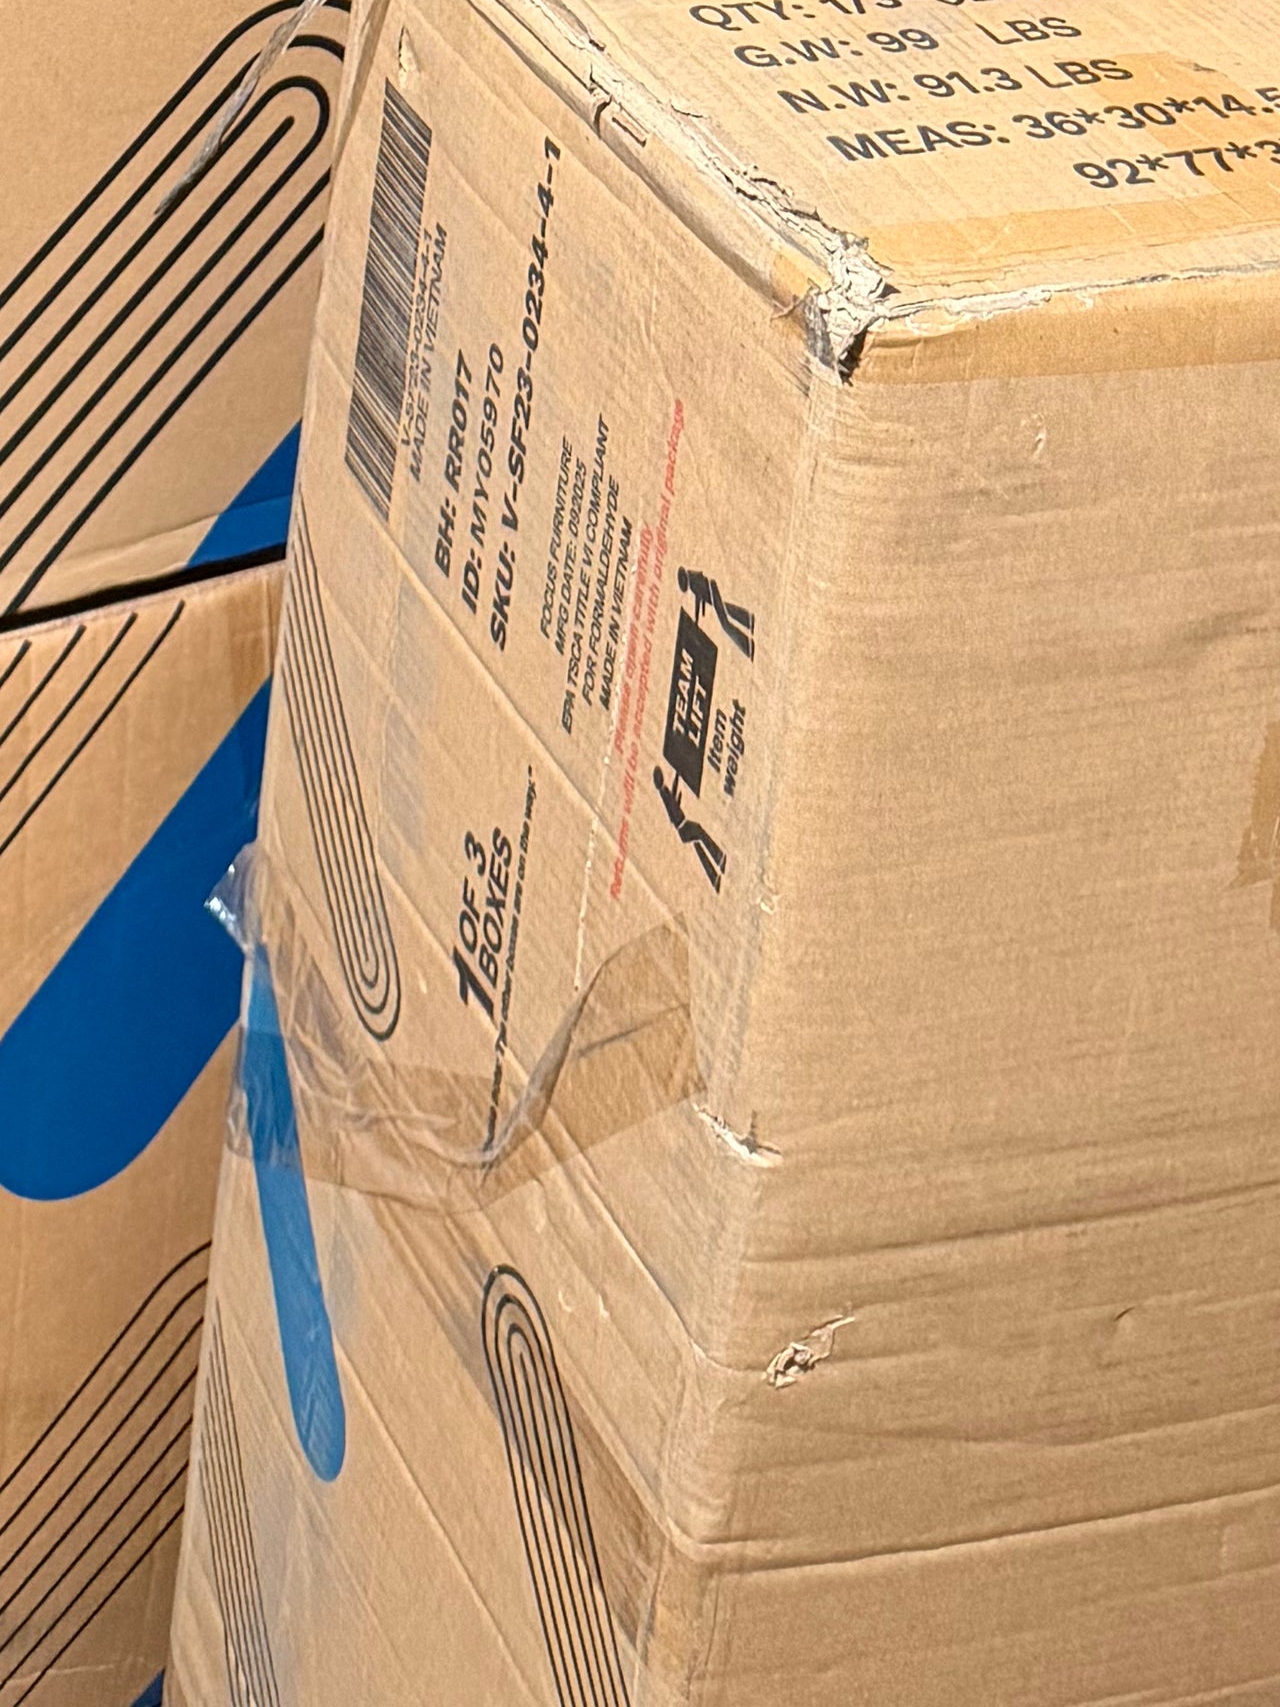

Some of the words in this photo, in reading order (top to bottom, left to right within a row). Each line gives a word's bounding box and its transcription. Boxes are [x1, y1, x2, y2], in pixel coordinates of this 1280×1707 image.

[733, 35, 864, 68] G.W:
[866, 27, 940, 54] 99
[975, 15, 1084, 46] LBS
[777, 78, 912, 115] N.W:
[913, 67, 1023, 100] 91.3
[1024, 58, 1135, 90] LBS
[825, 120, 1011, 162] MEAS:
[500, 134, 561, 532] V-SF23-0234-4-1
[443, 347, 473, 494] RR017
[469, 341, 504, 549] MY05970
[433, 496, 457, 579] BH:
[460, 546, 483, 616] ID:
[489, 540, 516, 650] SKU:
[673, 648, 694, 735] TEAM
[688, 674, 707, 748] LIFT
[707, 708, 727, 774] Item
[723, 698, 746, 798] weight
[464, 830, 486, 878] 3
[459, 876, 479, 954] OF
[478, 826, 512, 989] BOXES
